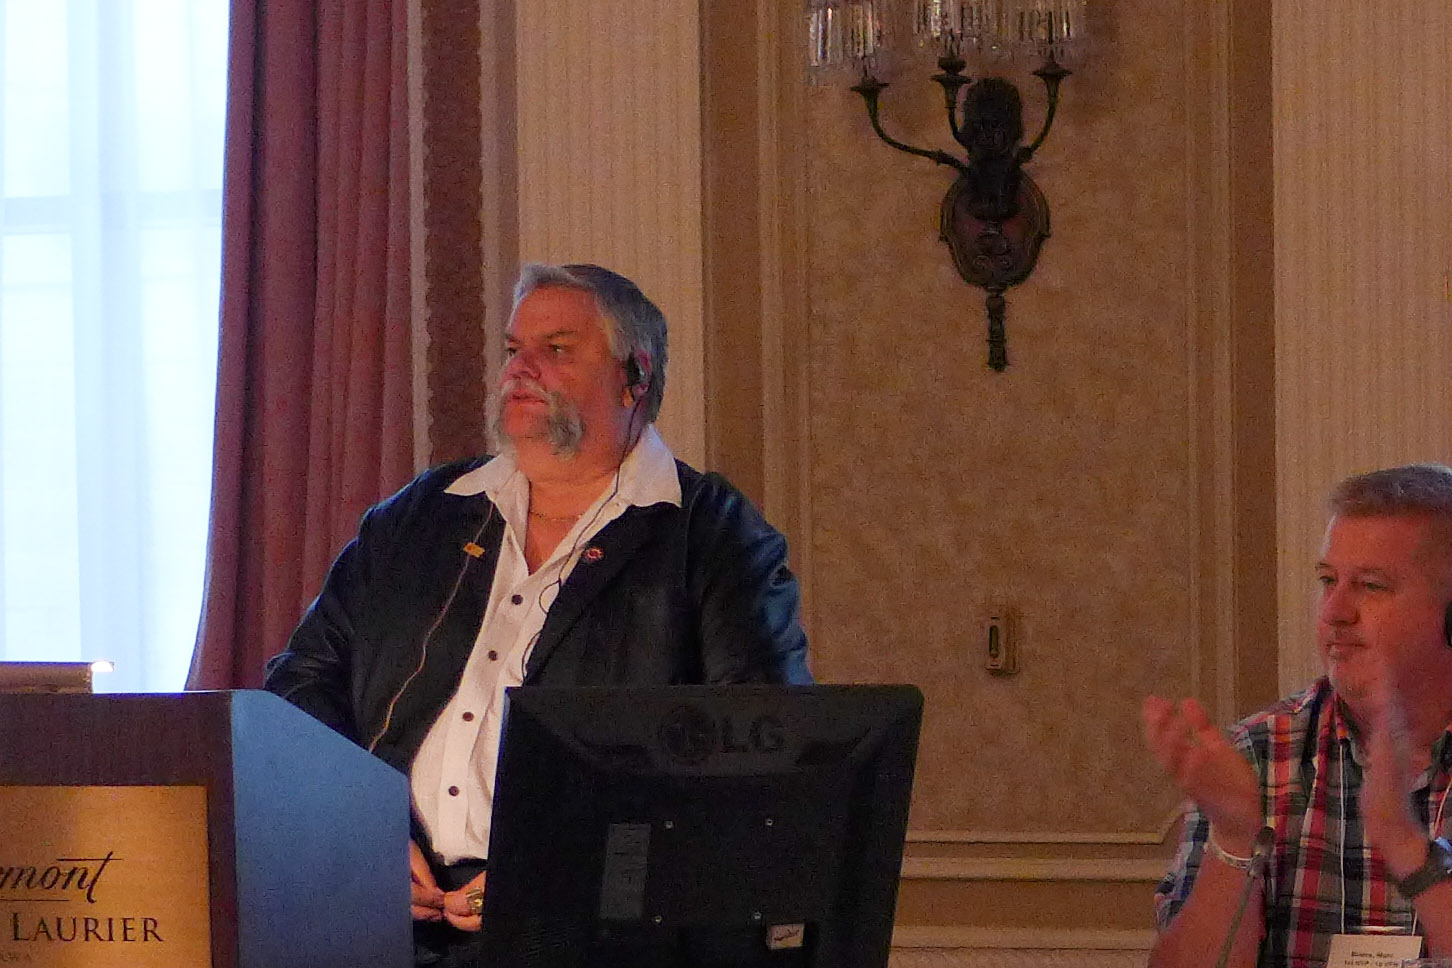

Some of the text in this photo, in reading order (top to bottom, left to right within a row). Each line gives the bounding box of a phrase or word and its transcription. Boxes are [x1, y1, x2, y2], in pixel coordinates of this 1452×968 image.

[721, 714, 786, 753] LG
[0, 851, 122, 904] mont
[12, 912, 164, 942] LAURIER
